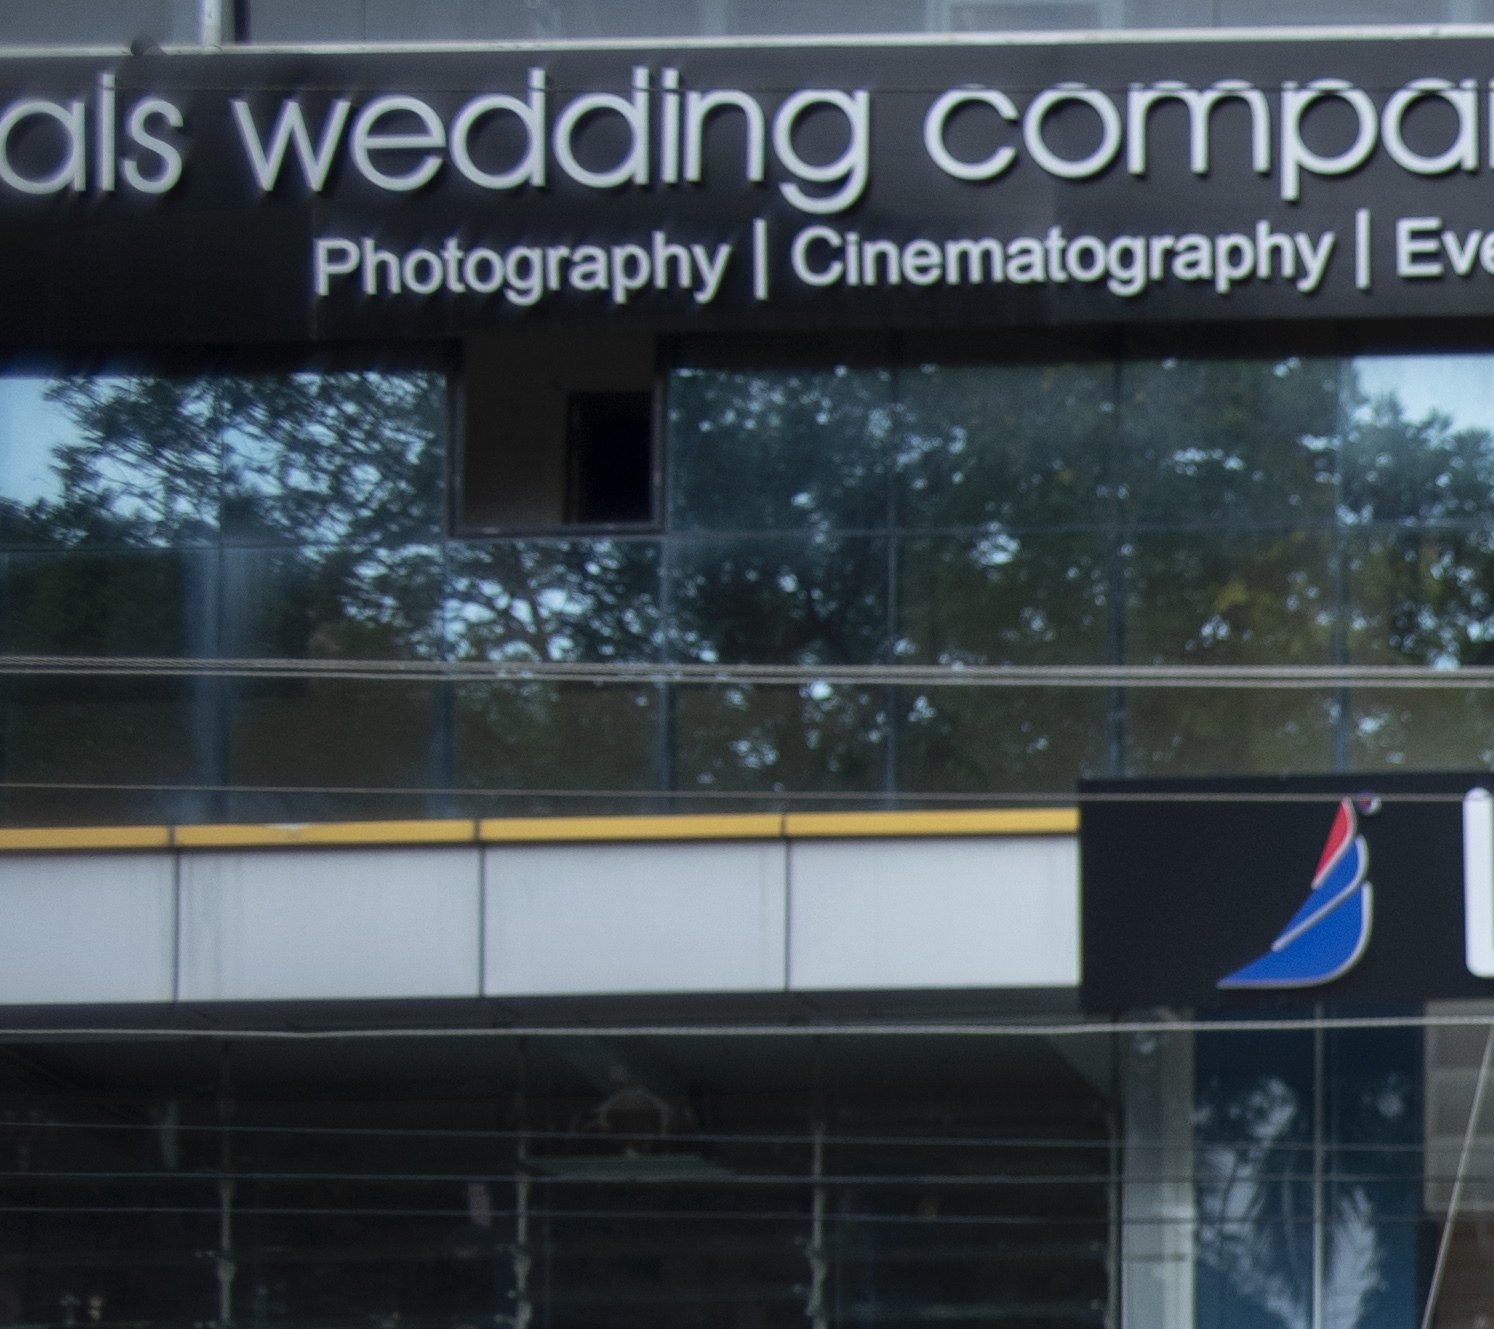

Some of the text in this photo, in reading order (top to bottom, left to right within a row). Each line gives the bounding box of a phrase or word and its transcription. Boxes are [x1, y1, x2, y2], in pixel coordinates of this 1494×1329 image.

[234, 67, 870, 213] wedding
[314, 231, 733, 306] Photography
[791, 214, 1334, 302] Cinematography
